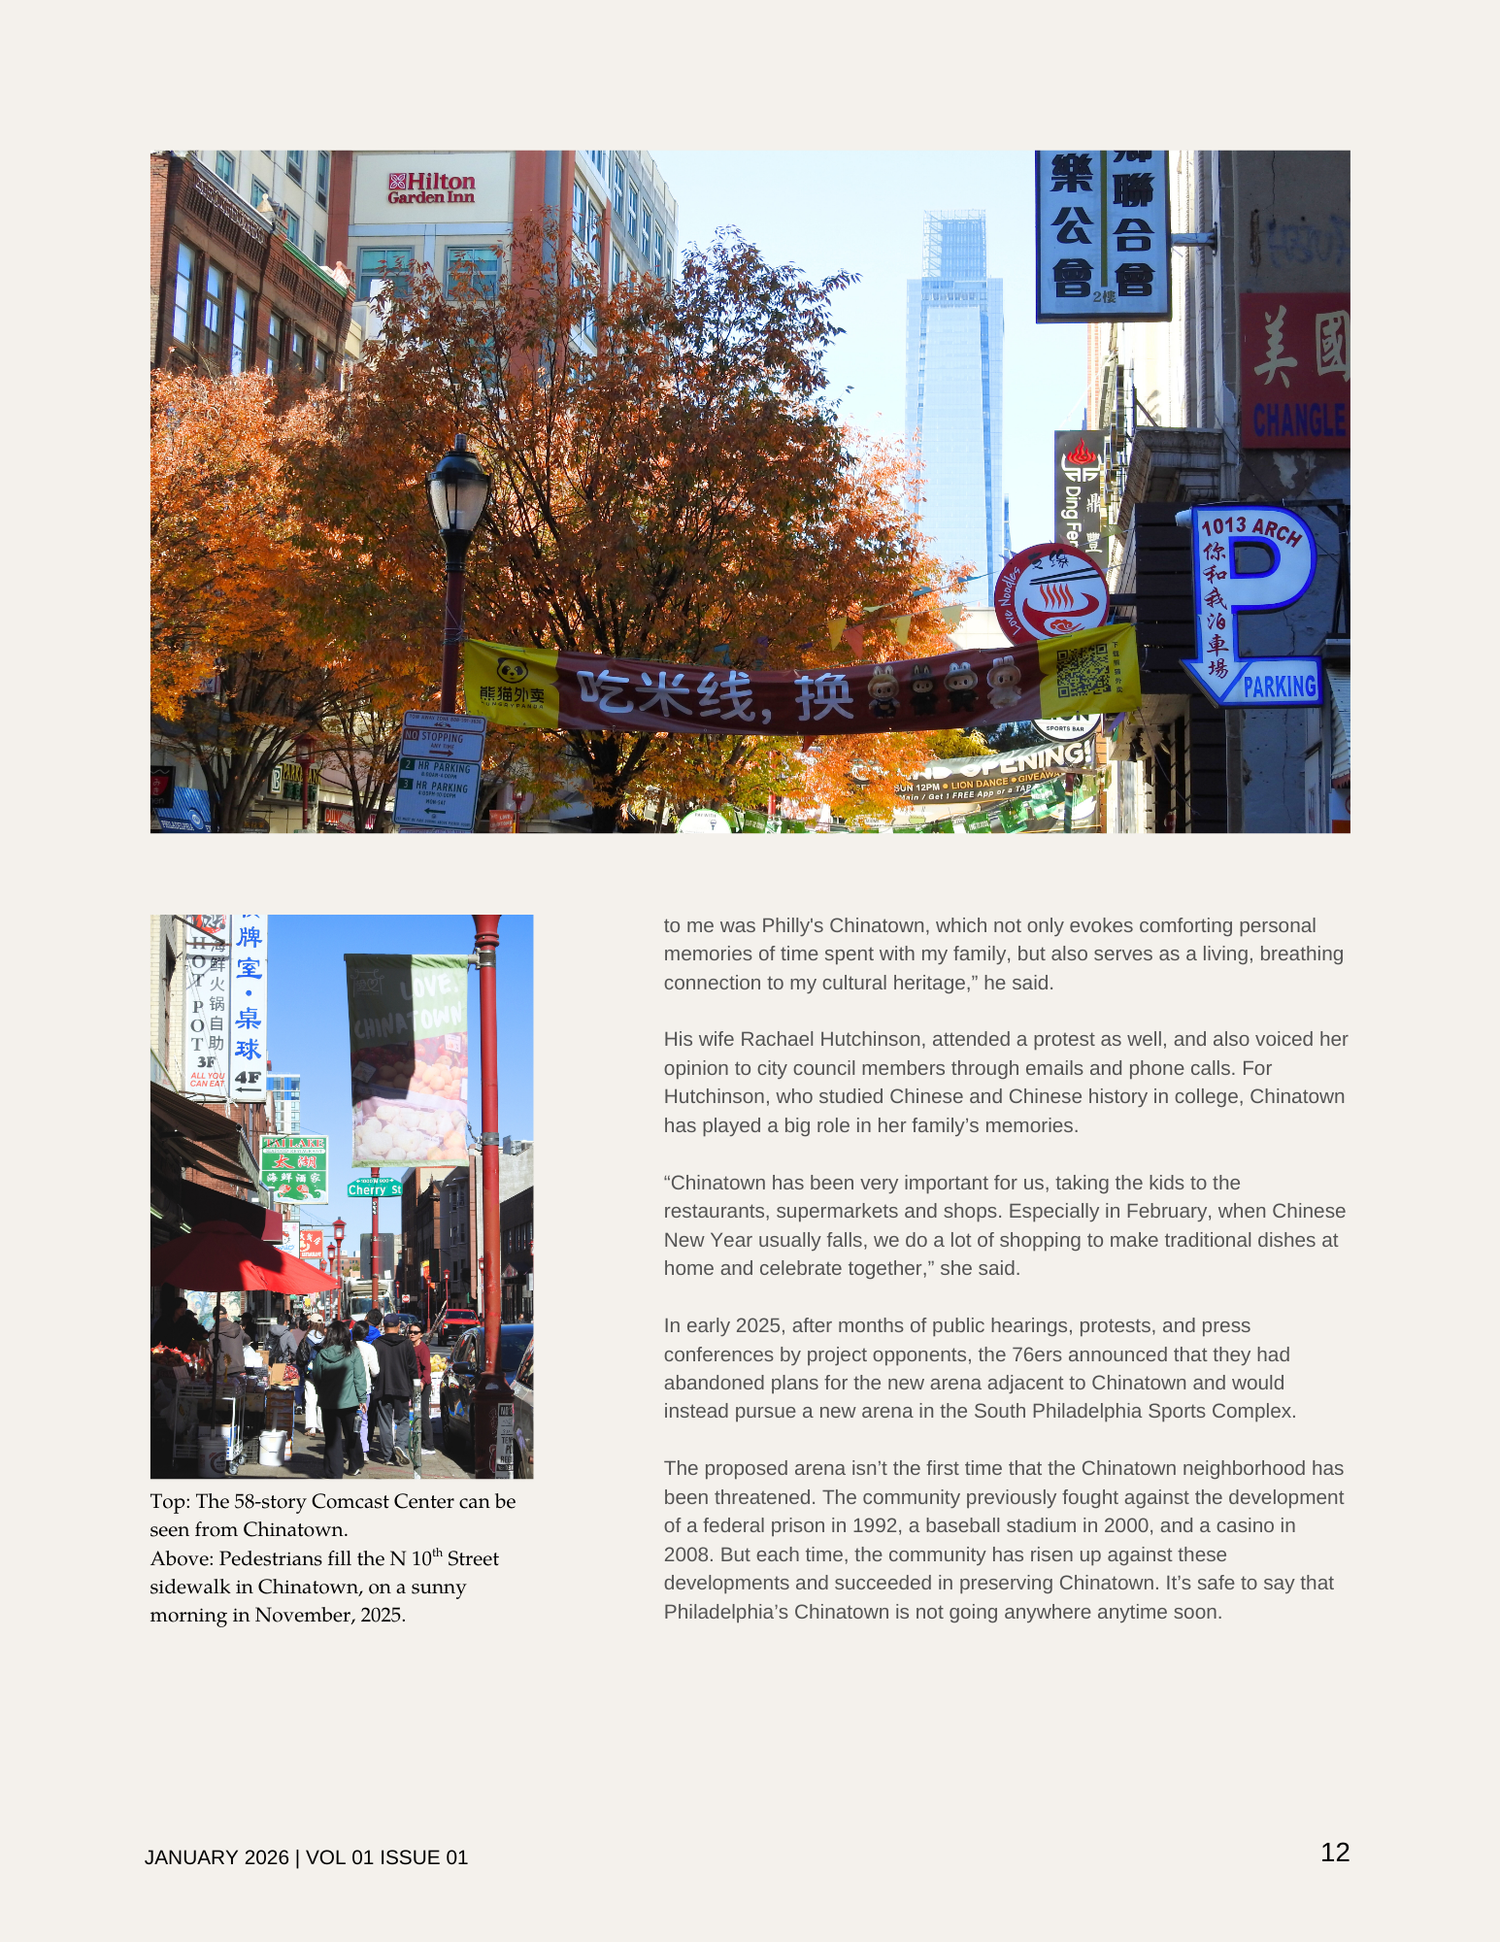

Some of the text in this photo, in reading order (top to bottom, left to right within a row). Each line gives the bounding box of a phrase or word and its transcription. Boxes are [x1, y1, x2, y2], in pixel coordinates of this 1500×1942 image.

[408, 172, 475, 190] Hilton
[388, 191, 475, 204] Garden Inn
[1113, 151, 1156, 297] 聯合會
[1253, 402, 1346, 437] CHANGLE
[1061, 486, 1081, 519] Ding
[1201, 516, 1302, 549] 1013 ARCH
[998, 566, 1021, 637] Love Noodles
[480, 686, 545, 703] 熊猫外卖
[1244, 675, 1317, 698] PARKING
[404, 730, 464, 744] NO STOPPING
[405, 760, 471, 774] 2 HR PARKING
[959, 740, 1093, 778] OPENING!
[403, 779, 468, 794] 3 HR PARKING
[917, 783, 940, 792] 12PM
[951, 781, 974, 790] LION
[976, 778, 1009, 788] DANCE
[952, 790, 974, 799] FREE
[977, 789, 994, 799] App
[664, 974, 1054, 995] connection to my cultural heritage,” he said.
[190, 1000, 205, 1052] POT
[354, 1001, 463, 1039] CHINATOWN
[197, 1056, 217, 1068] 3F
[190, 1072, 226, 1080] ALL YOU
[190, 1080, 208, 1088] CAN
[235, 1071, 262, 1084] 4F
[264, 1138, 325, 1148] TAI LAKE
[271, 1154, 317, 1169] 太湖
[348, 1185, 402, 1196] Cherry St
[664, 1259, 1020, 1280] home and celebrate together,” she said.
[149, 1492, 517, 1515] Top: The 58-story Comcast Center can be
[149, 1520, 348, 1538] seen from Chinatown.
[149, 1547, 500, 1567] Above: Pedestrians fill the N 10th Street
[149, 1578, 467, 1600] sidewalk in Chinatown, on a sunny
[149, 1606, 406, 1628] morning in November, 2025.
[664, 1603, 1222, 1624] Philadelphia’s Chinatown is not going anywhere anytime soon.
[144, 1848, 469, 1870] JANUARY 2026 | VOL 01 ISSUE 01
[1321, 1841, 1350, 1862] 12
